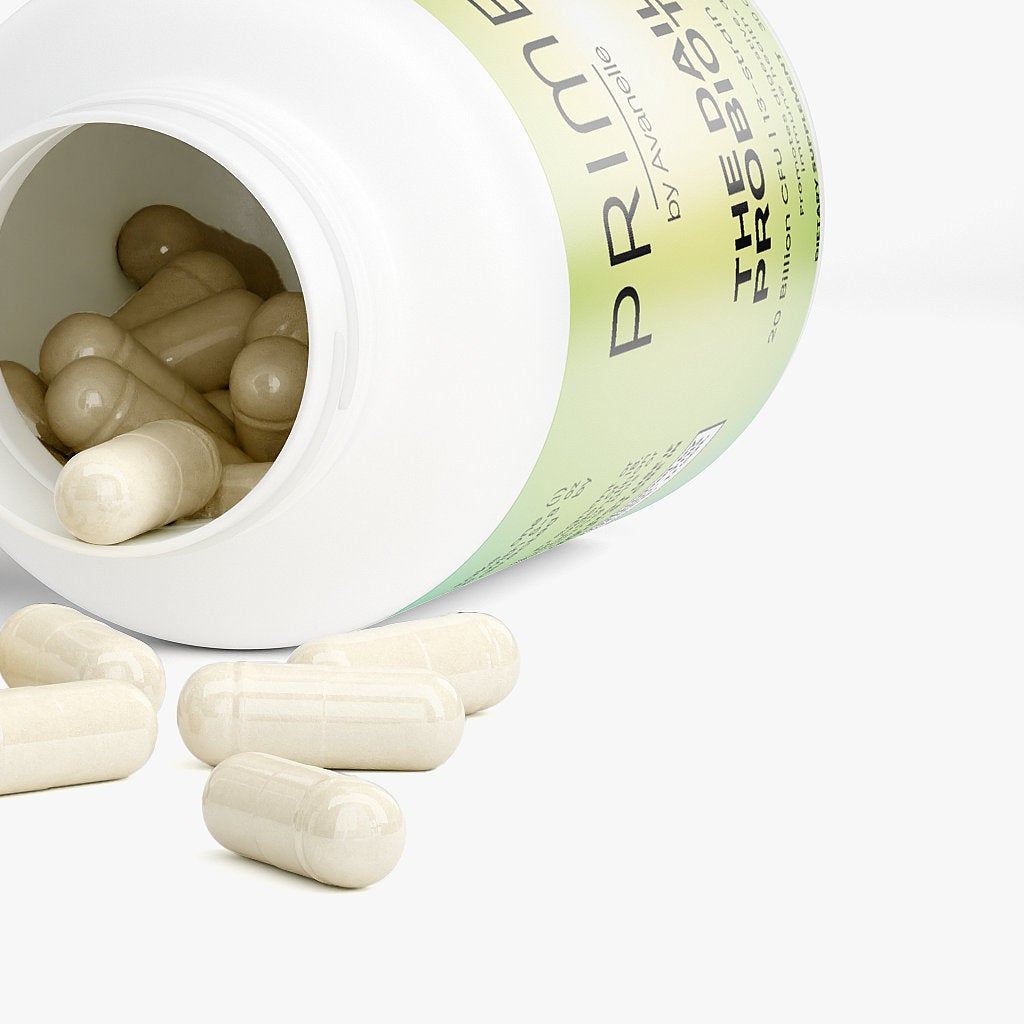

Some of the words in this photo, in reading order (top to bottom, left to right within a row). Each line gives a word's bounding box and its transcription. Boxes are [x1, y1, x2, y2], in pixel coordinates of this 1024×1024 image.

[595, 46, 669, 173] Avanelle
[662, 181, 681, 222] by
[773, 148, 788, 204] CFU
[719, 150, 753, 302] THE
[779, 214, 791, 299] Billion
